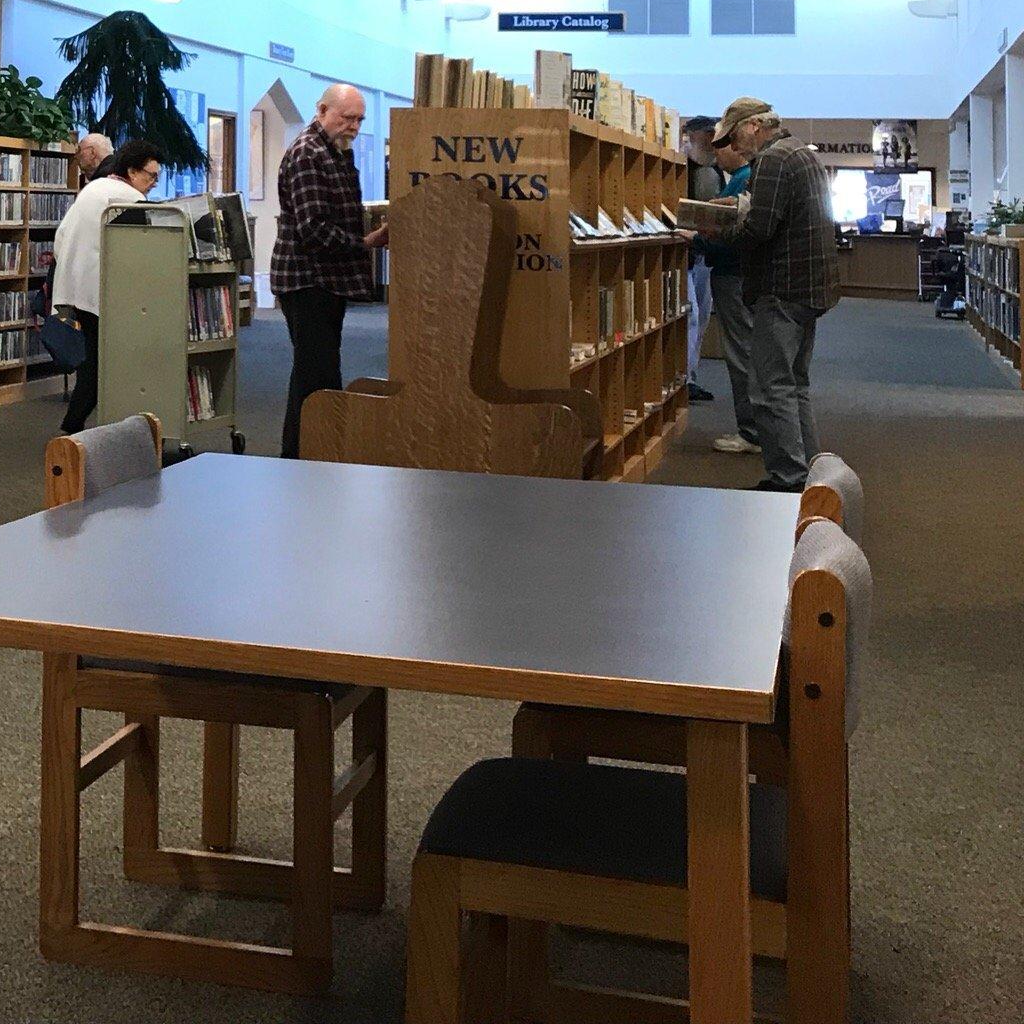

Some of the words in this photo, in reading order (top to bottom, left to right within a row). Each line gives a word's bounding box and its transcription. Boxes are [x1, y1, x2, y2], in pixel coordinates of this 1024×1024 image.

[513, 16, 559, 29] Library
[561, 16, 610, 30] Catalog
[572, 72, 596, 91] HOW
[431, 135, 524, 164] NEW
[810, 142, 874, 154] RMATIO
[409, 171, 549, 202] OKS
